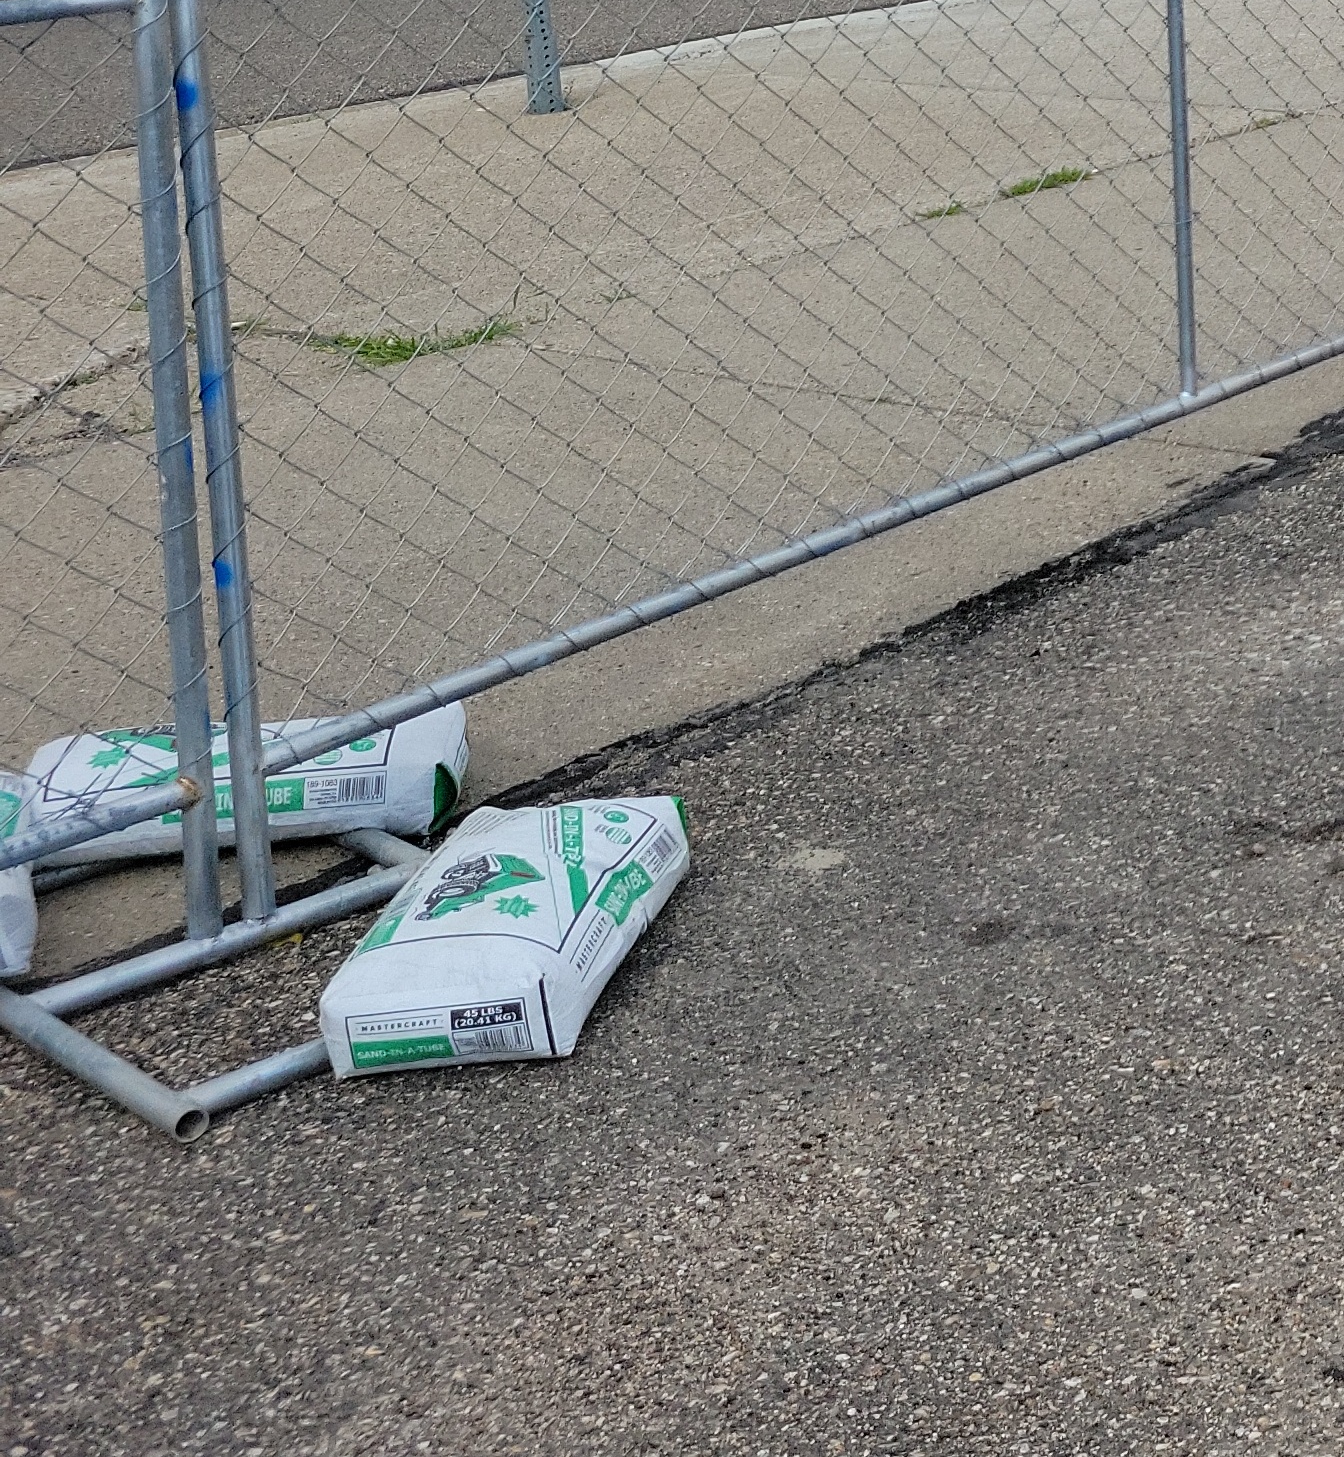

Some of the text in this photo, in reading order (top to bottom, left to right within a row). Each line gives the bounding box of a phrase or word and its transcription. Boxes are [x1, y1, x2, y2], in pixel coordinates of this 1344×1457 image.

[464, 1006, 503, 1018] 45 LBS
[360, 1012, 517, 1032] MASTERCRAFT (20.41 KG)
